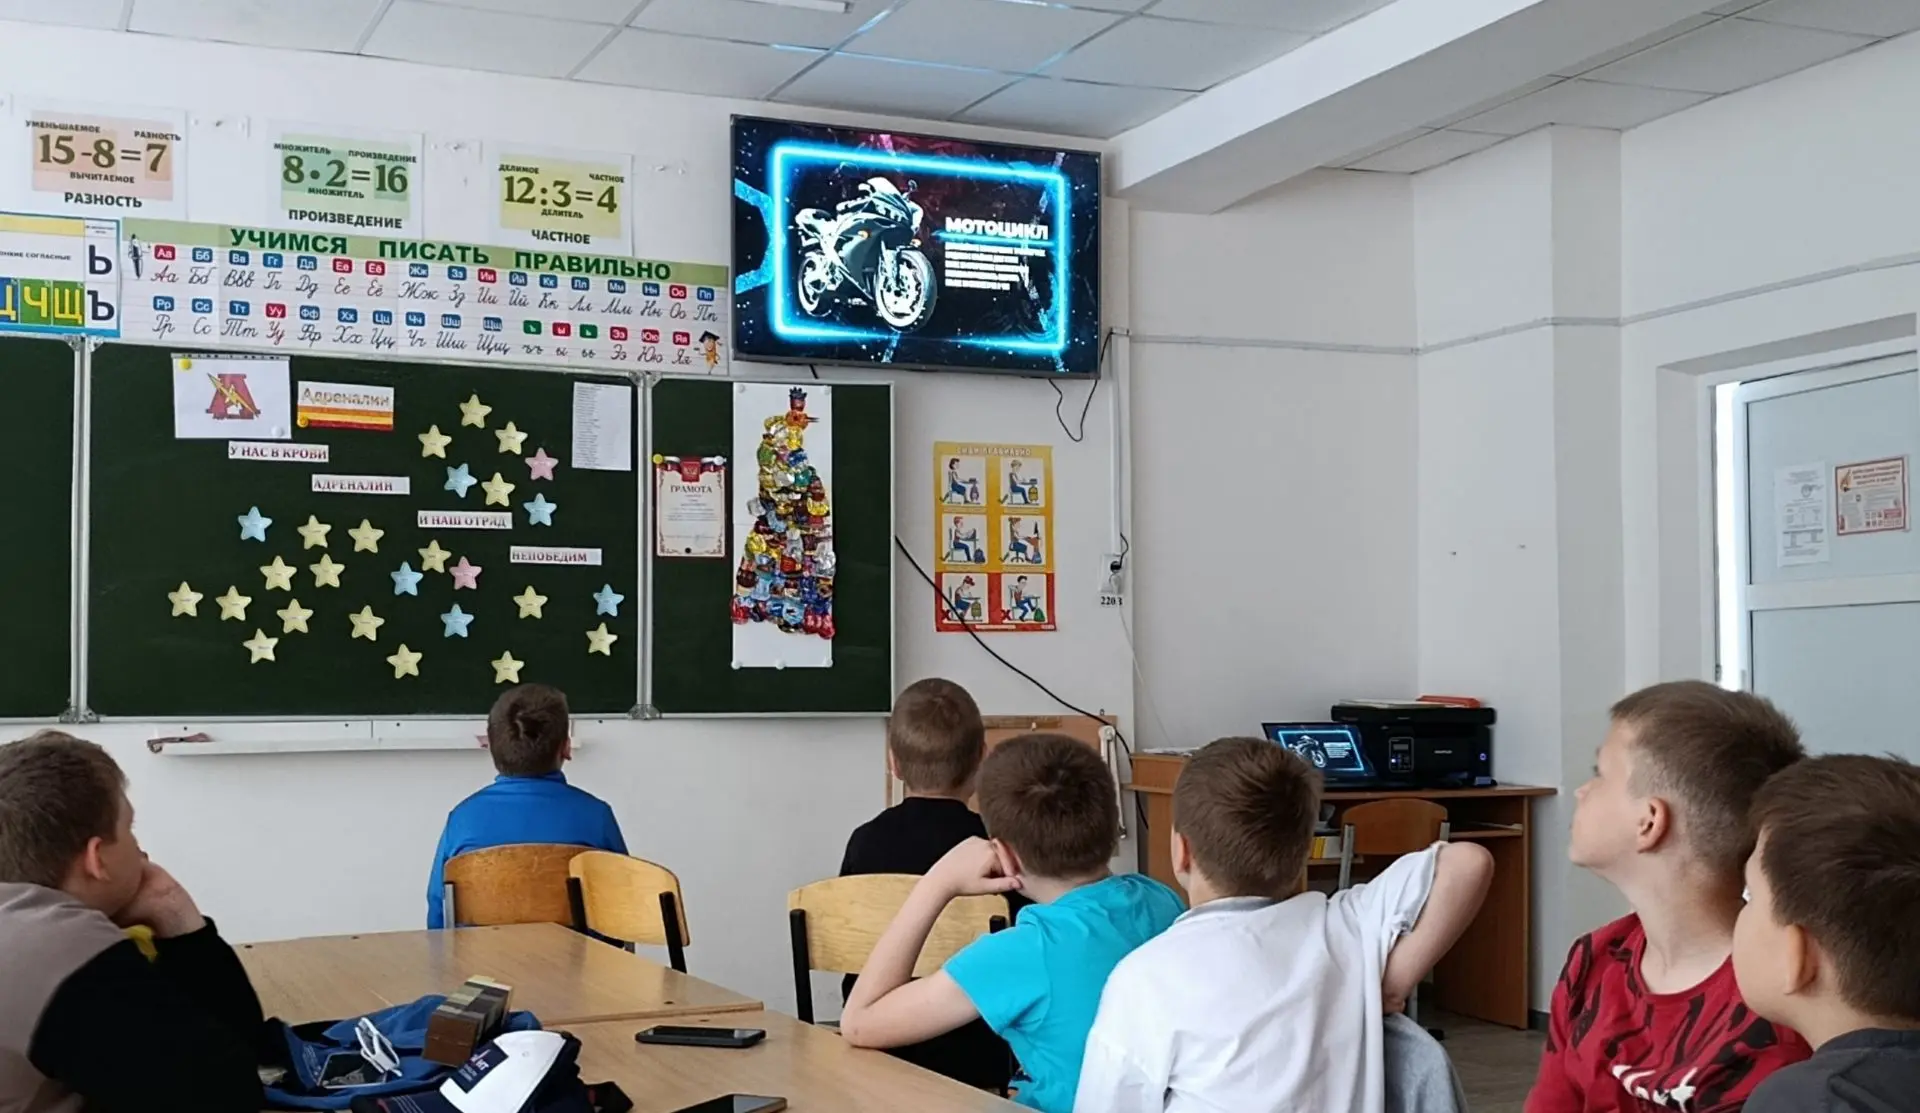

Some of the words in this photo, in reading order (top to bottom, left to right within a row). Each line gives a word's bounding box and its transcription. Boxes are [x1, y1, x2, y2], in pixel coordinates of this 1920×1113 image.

[26, 120, 100, 133] УМЕНЬШАЕМОЕ
[134, 130, 181, 141] РАЗНОСТЬ
[274, 143, 331, 155] МНОЖИТЕЛЬ
[348, 150, 417, 163] ПРОИЗВЕДЕНИЕ
[498, 164, 539, 174] ДЕЛИМОЕ
[70, 172, 134, 183] ВЫЧИТАЕМОЕ
[589, 174, 625, 183] ЧАСТНОЕ
[308, 188, 364, 198] МНОЖИТЕЛЬ
[65, 192, 142, 208] РАЗНОСТЬ
[289, 209, 402, 229] ПРОИЗВЕДЕНИЕ
[541, 209, 583, 219] ДЕЛИТЕЛЬ
[945, 217, 1048, 240] МОТОЦИКЛ
[532, 230, 590, 244] ЧАСТНОЕ
[25, 252, 71, 260] СОГЛАСНЫЕ
[230, 228, 347, 254] УЧИМСЯ
[379, 241, 489, 264] ПИСАТЬ
[515, 252, 671, 280] ПРАВИЛЬНО
[303, 387, 389, 407] Адреналин
[230, 446, 237, 455] У
[242, 447, 267, 458] НАС
[272, 448, 281, 458] В
[283, 449, 327, 460] КРОВИ
[314, 479, 393, 492] АДРЕНАЛИН
[671, 485, 712, 493] ГРАМОТА
[420, 517, 428, 525] И
[432, 516, 461, 525] НАШ
[464, 517, 506, 528] ОТРЯД
[512, 551, 587, 563] НЕПОБЕДИМ
